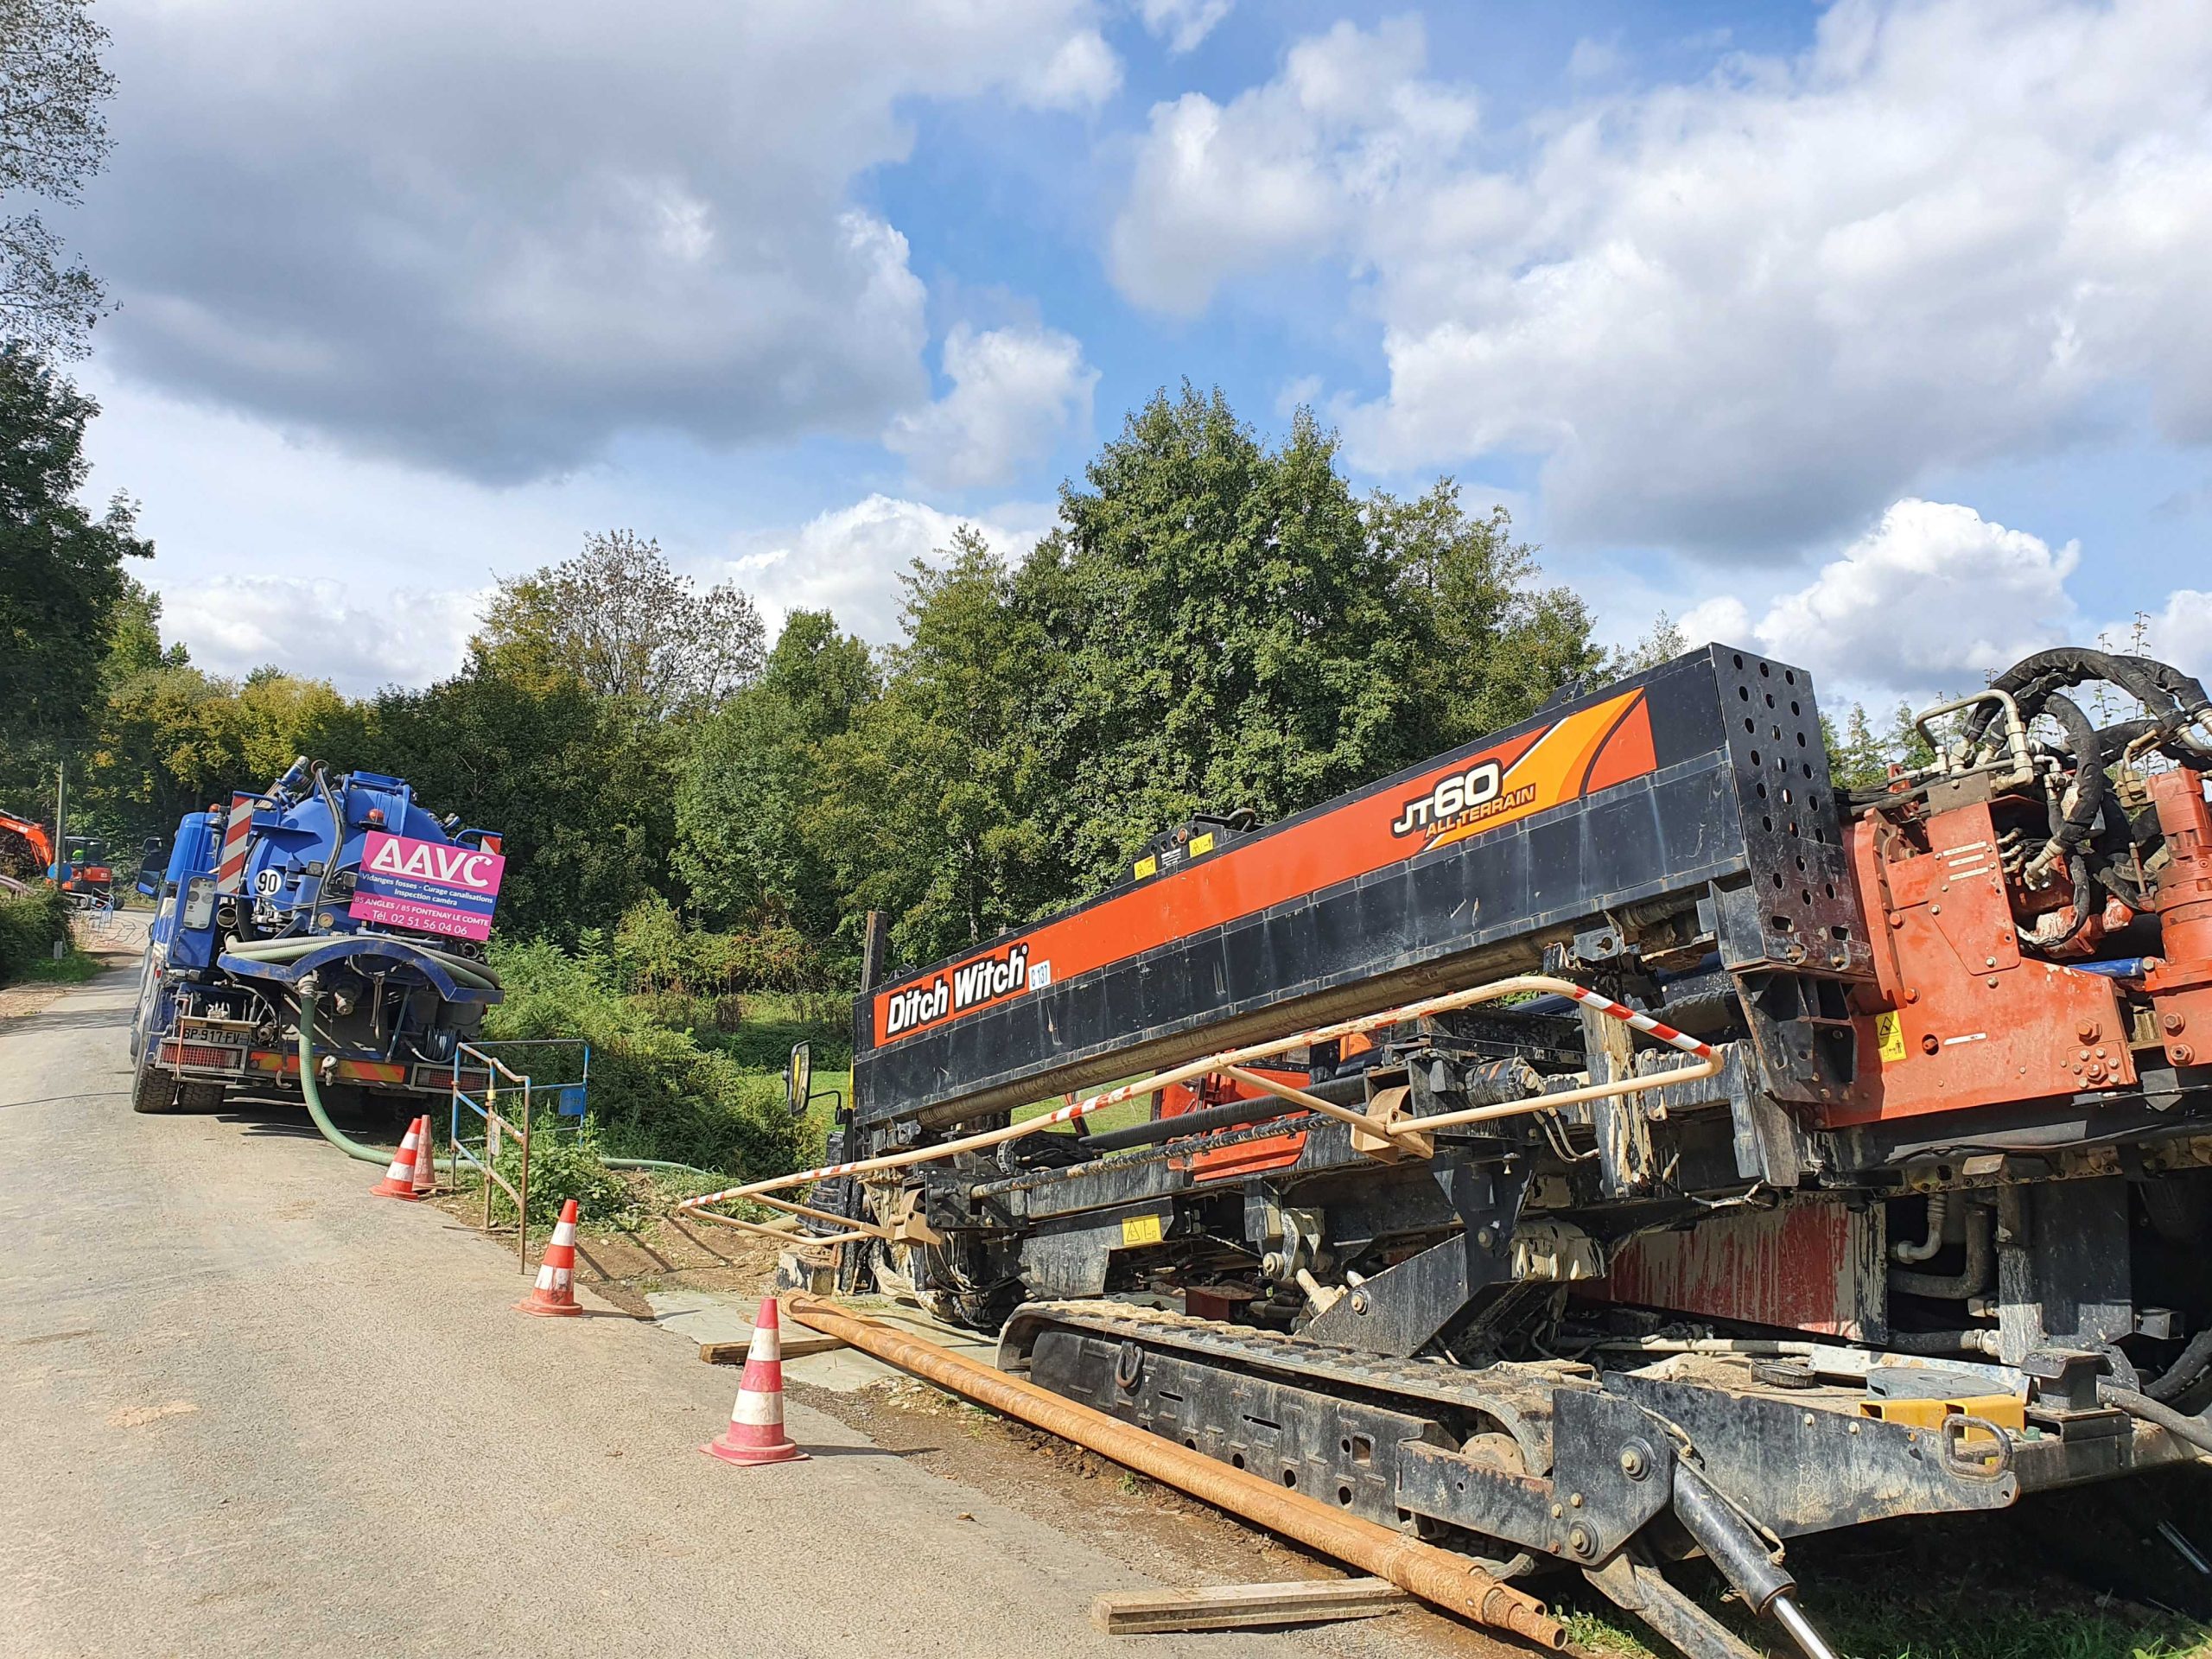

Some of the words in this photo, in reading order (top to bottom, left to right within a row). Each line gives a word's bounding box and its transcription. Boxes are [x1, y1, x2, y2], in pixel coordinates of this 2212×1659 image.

[1425, 817, 1456, 838] ALL
[1459, 785, 1534, 824] TERRAIN
[370, 837, 493, 887] AAVC
[257, 872, 277, 893] 90
[361, 873, 394, 886] Vidanges
[395, 879, 417, 890] fosses
[423, 884, 448, 897] Curage
[449, 889, 493, 904] canalisations
[394, 888, 431, 901] Inspection
[432, 896, 458, 906] caméra
[365, 899, 395, 909] ANGLES
[411, 906, 452, 919] FONTENAY
[463, 916, 490, 927] COMTE
[372, 910, 388, 922] Tél.
[391, 913, 404, 924] 02
[407, 916, 420, 927] 51
[423, 919, 436, 930] 56
[438, 922, 452, 933] 04
[454, 925, 467, 936] 06
[887, 977, 950, 1034] Ditch
